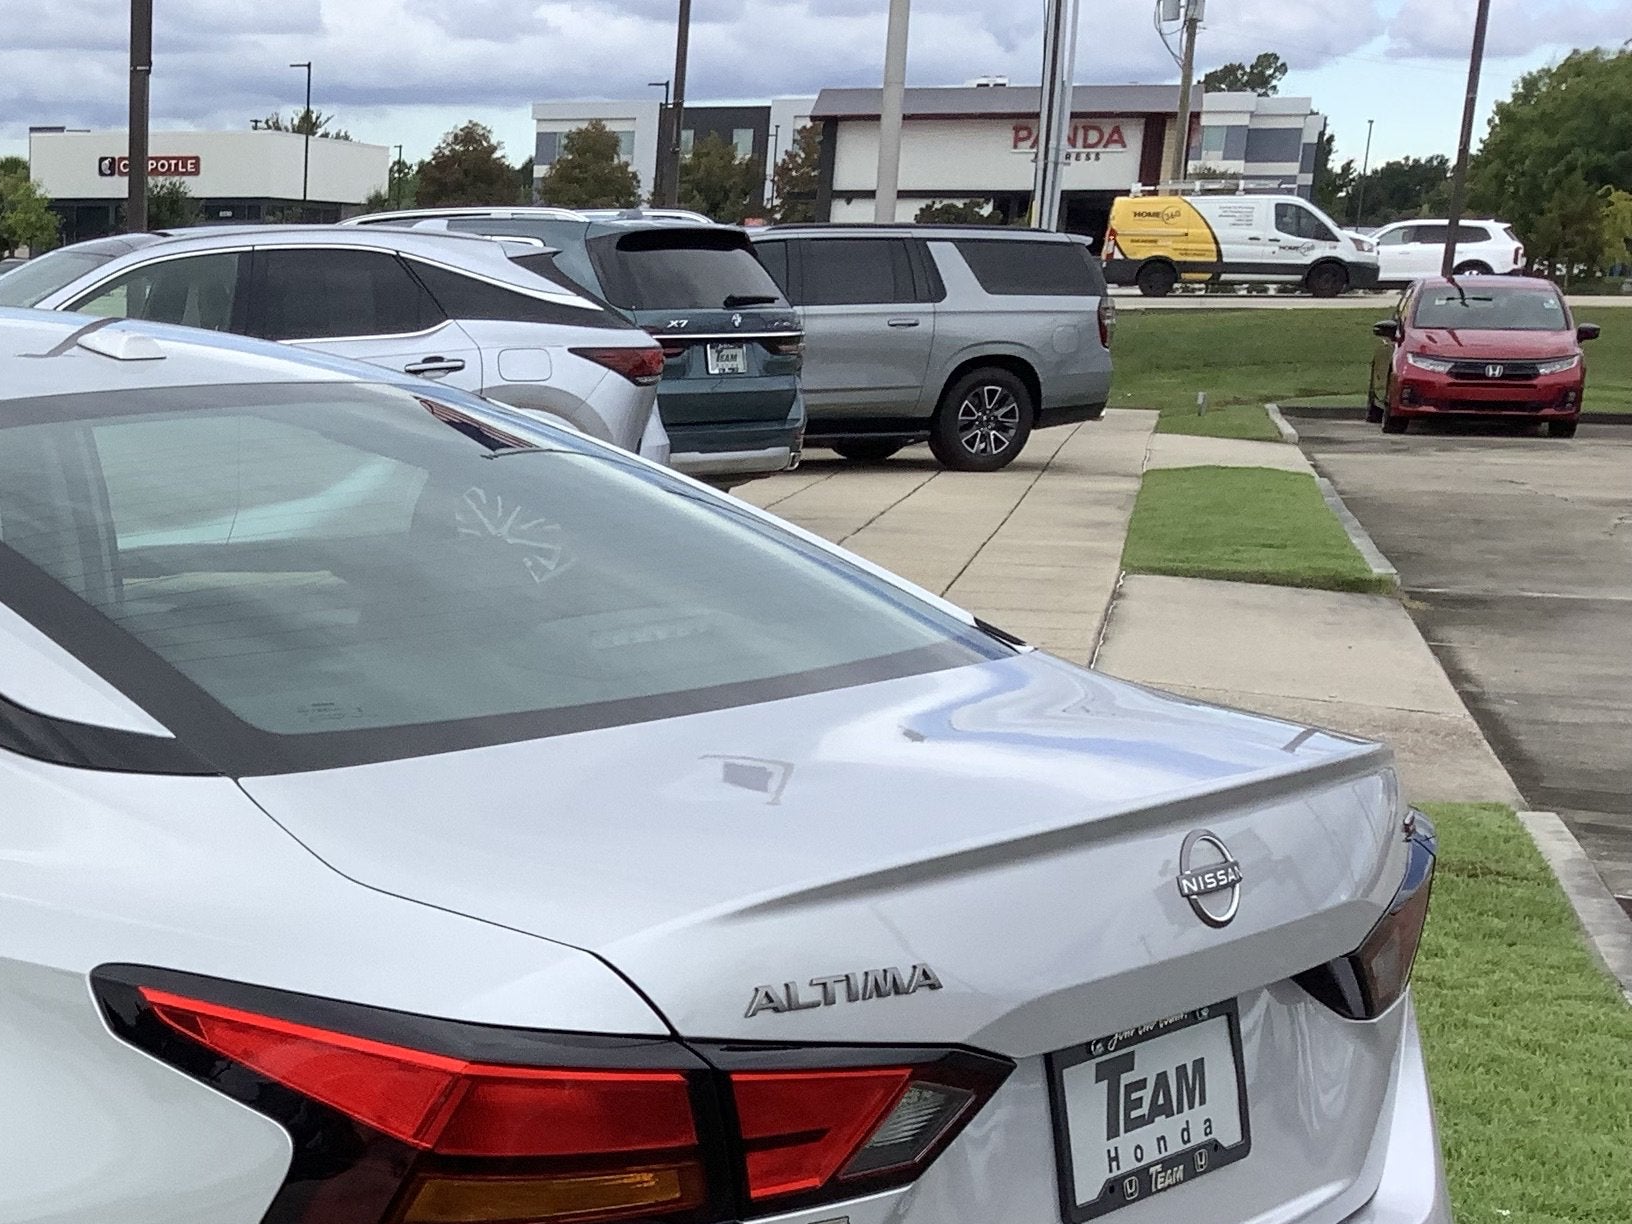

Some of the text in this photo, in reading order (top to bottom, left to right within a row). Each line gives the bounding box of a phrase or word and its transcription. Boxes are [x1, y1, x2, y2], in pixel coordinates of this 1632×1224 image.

[119, 159, 196, 172] CPOTLE
[667, 319, 689, 329] X7
[1181, 865, 1244, 894] NISSAN
[744, 962, 944, 1019] ALTIMA
[1094, 1050, 1207, 1142] TEAM
[1107, 1117, 1213, 1174] Honda
[1149, 1164, 1185, 1193] TEAM
